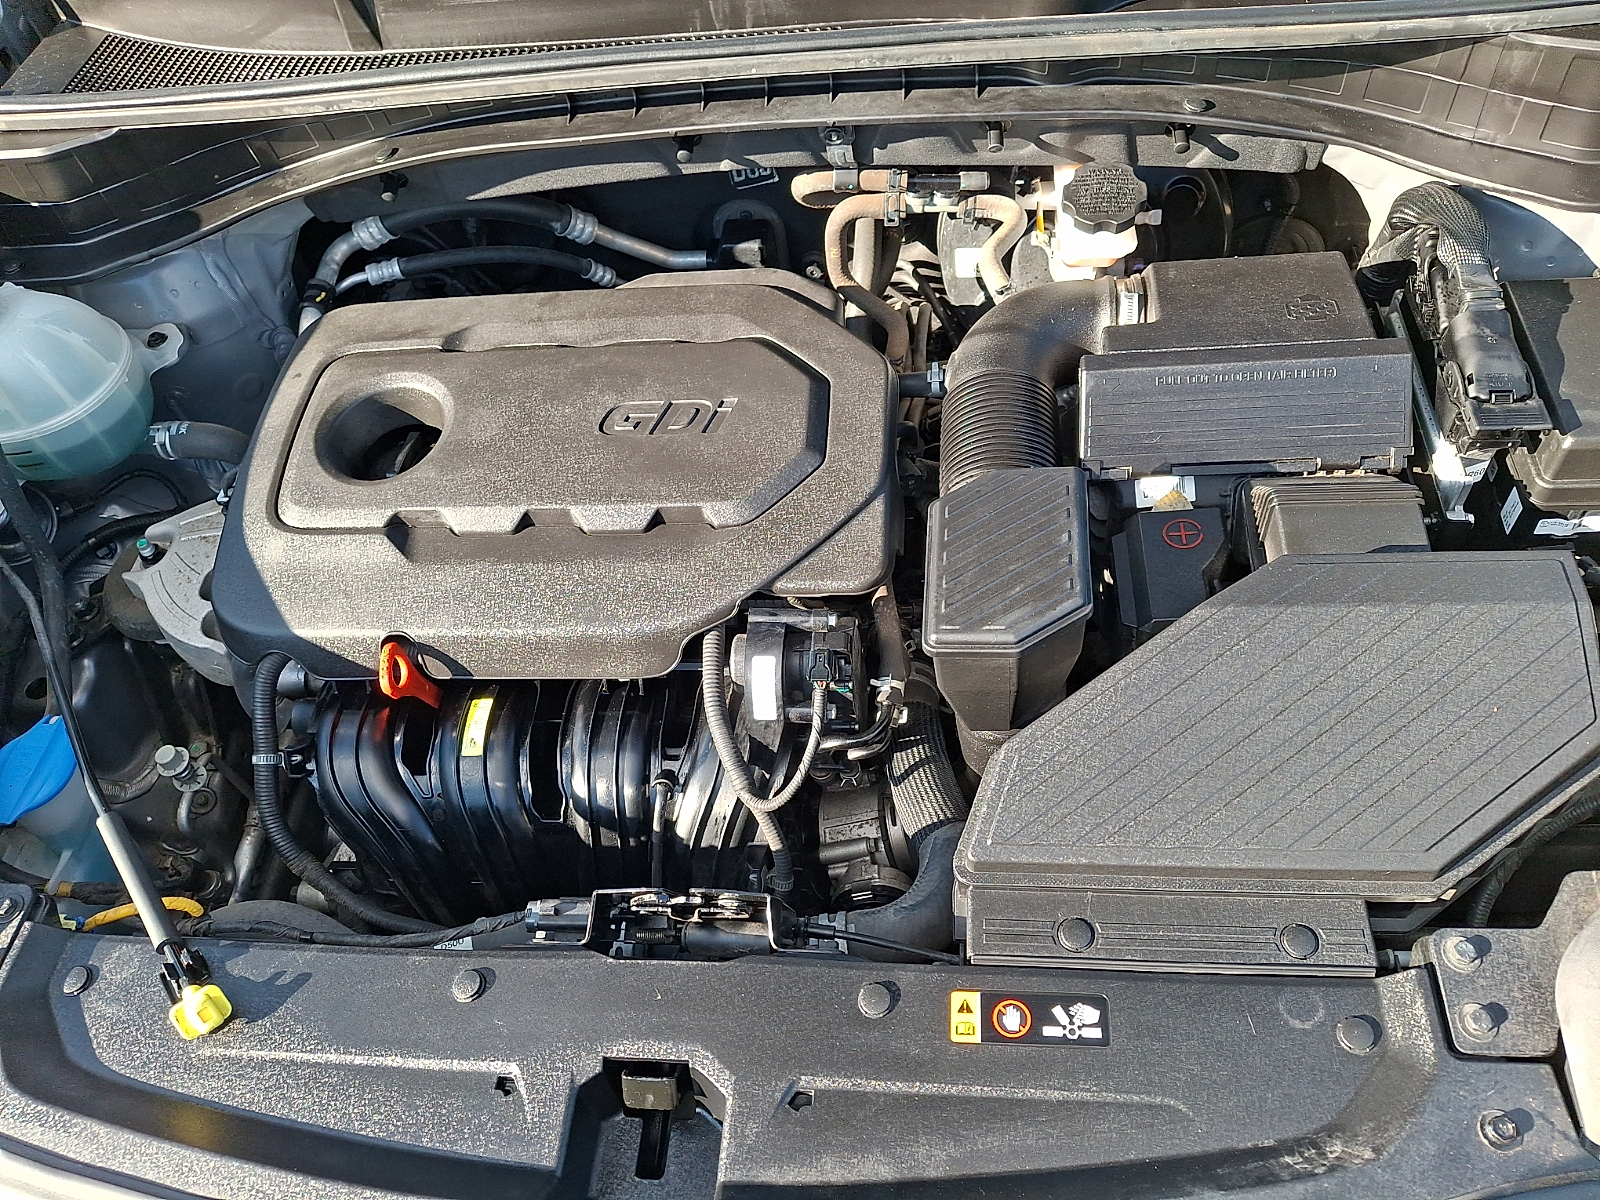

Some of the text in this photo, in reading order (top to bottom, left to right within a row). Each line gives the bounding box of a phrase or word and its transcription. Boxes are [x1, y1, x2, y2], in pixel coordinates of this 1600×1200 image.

[1155, 366, 1337, 387] PULL OUT TO OPEN (AIR FILTER)
